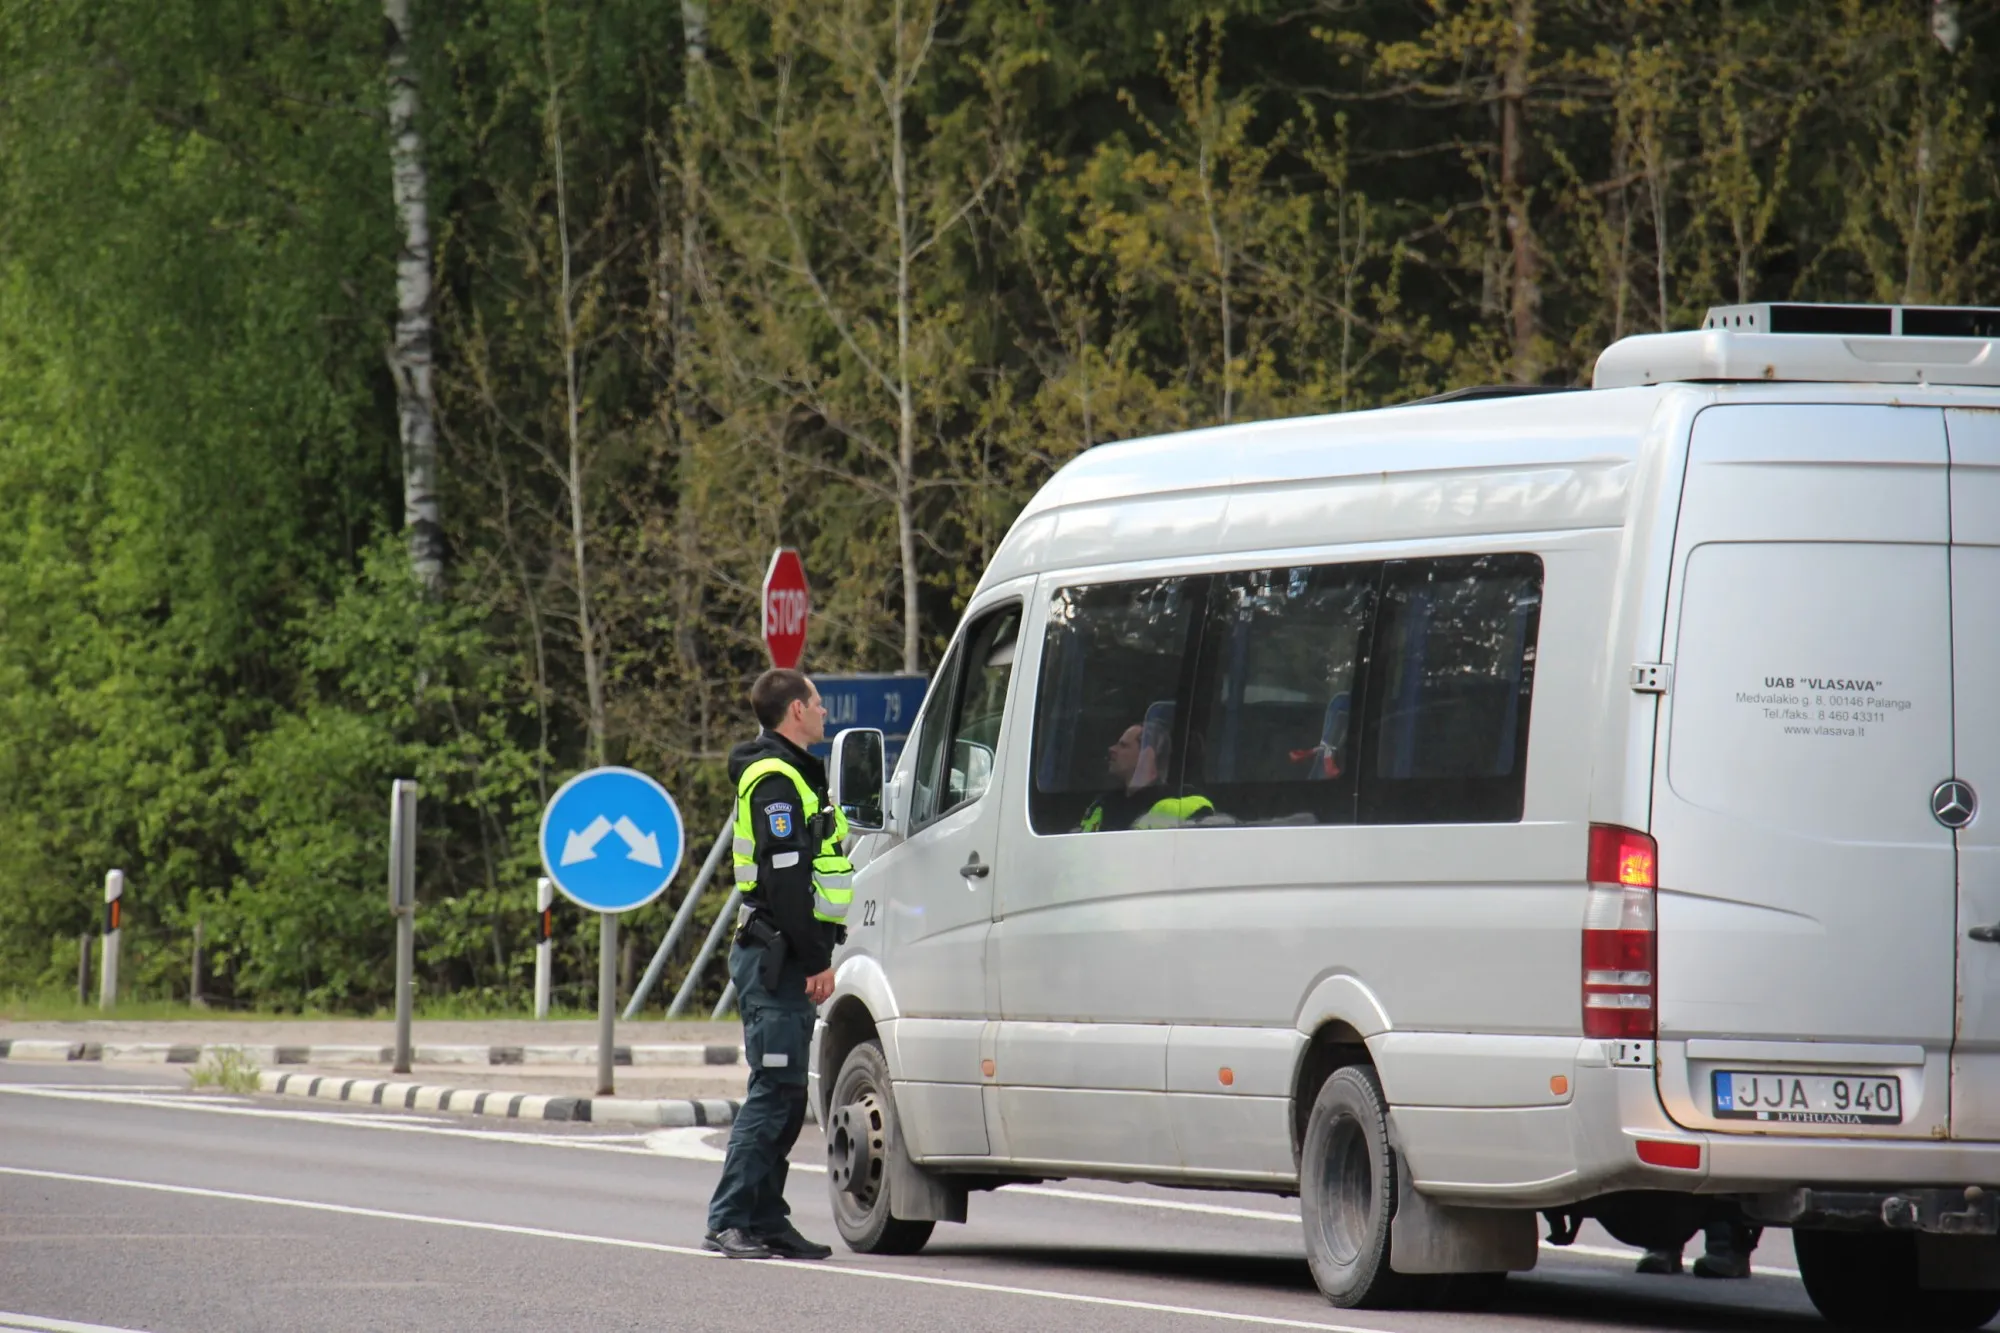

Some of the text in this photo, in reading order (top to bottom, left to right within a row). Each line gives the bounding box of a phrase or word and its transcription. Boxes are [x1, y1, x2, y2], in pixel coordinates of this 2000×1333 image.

[767, 589, 806, 636] STOP
[1764, 677, 1883, 692] UAB "VLASAVA"
[884, 692, 902, 724] 79
[1736, 692, 1799, 705] Medvalakio
[1829, 696, 1864, 707] 00146
[1867, 697, 1912, 711] Palanga
[1818, 710, 1825, 721] 8
[1828, 711, 1849, 721] 460
[1852, 712, 1884, 723] 43311
[1783, 725, 1865, 737] www.vlasava.lt
[765, 803, 792, 812] LIETUVA
[863, 900, 876, 926] 22
[1717, 1096, 1732, 1105] LT
[1738, 1078, 1893, 1112] JJA 940
[1778, 1111, 1862, 1124] LITHUANIA
